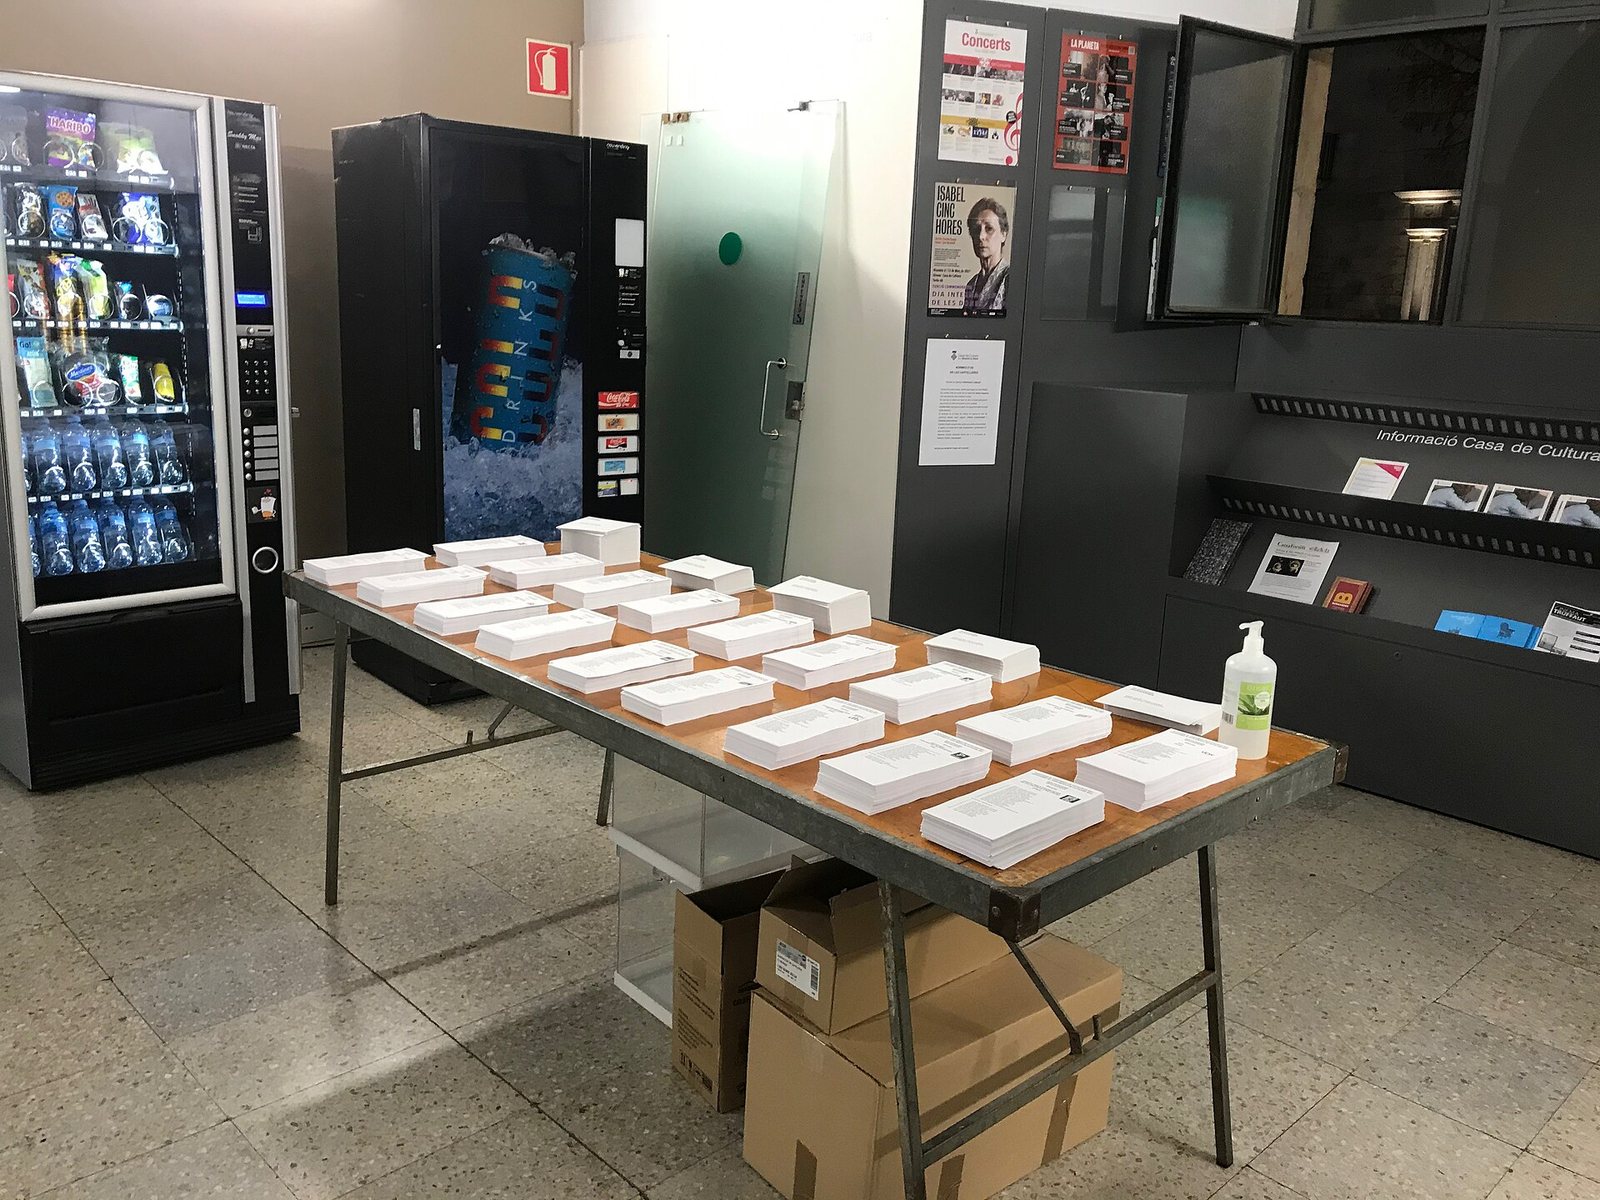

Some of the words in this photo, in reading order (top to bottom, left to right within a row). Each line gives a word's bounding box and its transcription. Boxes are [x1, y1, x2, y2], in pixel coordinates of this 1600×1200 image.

[961, 32, 1011, 51] Concerts
[1071, 38, 1078, 48] LA
[1078, 39, 1100, 51] PLANETA
[50, 117, 91, 134] HARIBO
[937, 185, 966, 203] ISABEL
[936, 202, 956, 218] CINC
[935, 219, 963, 235] HORES
[932, 290, 945, 298] DIA
[501, 279, 537, 443] DRINKS
[1376, 428, 1458, 448] Informació
[1462, 437, 1504, 452] Casa
[1510, 441, 1533, 455] de
[1538, 444, 1600, 462] Cultura
